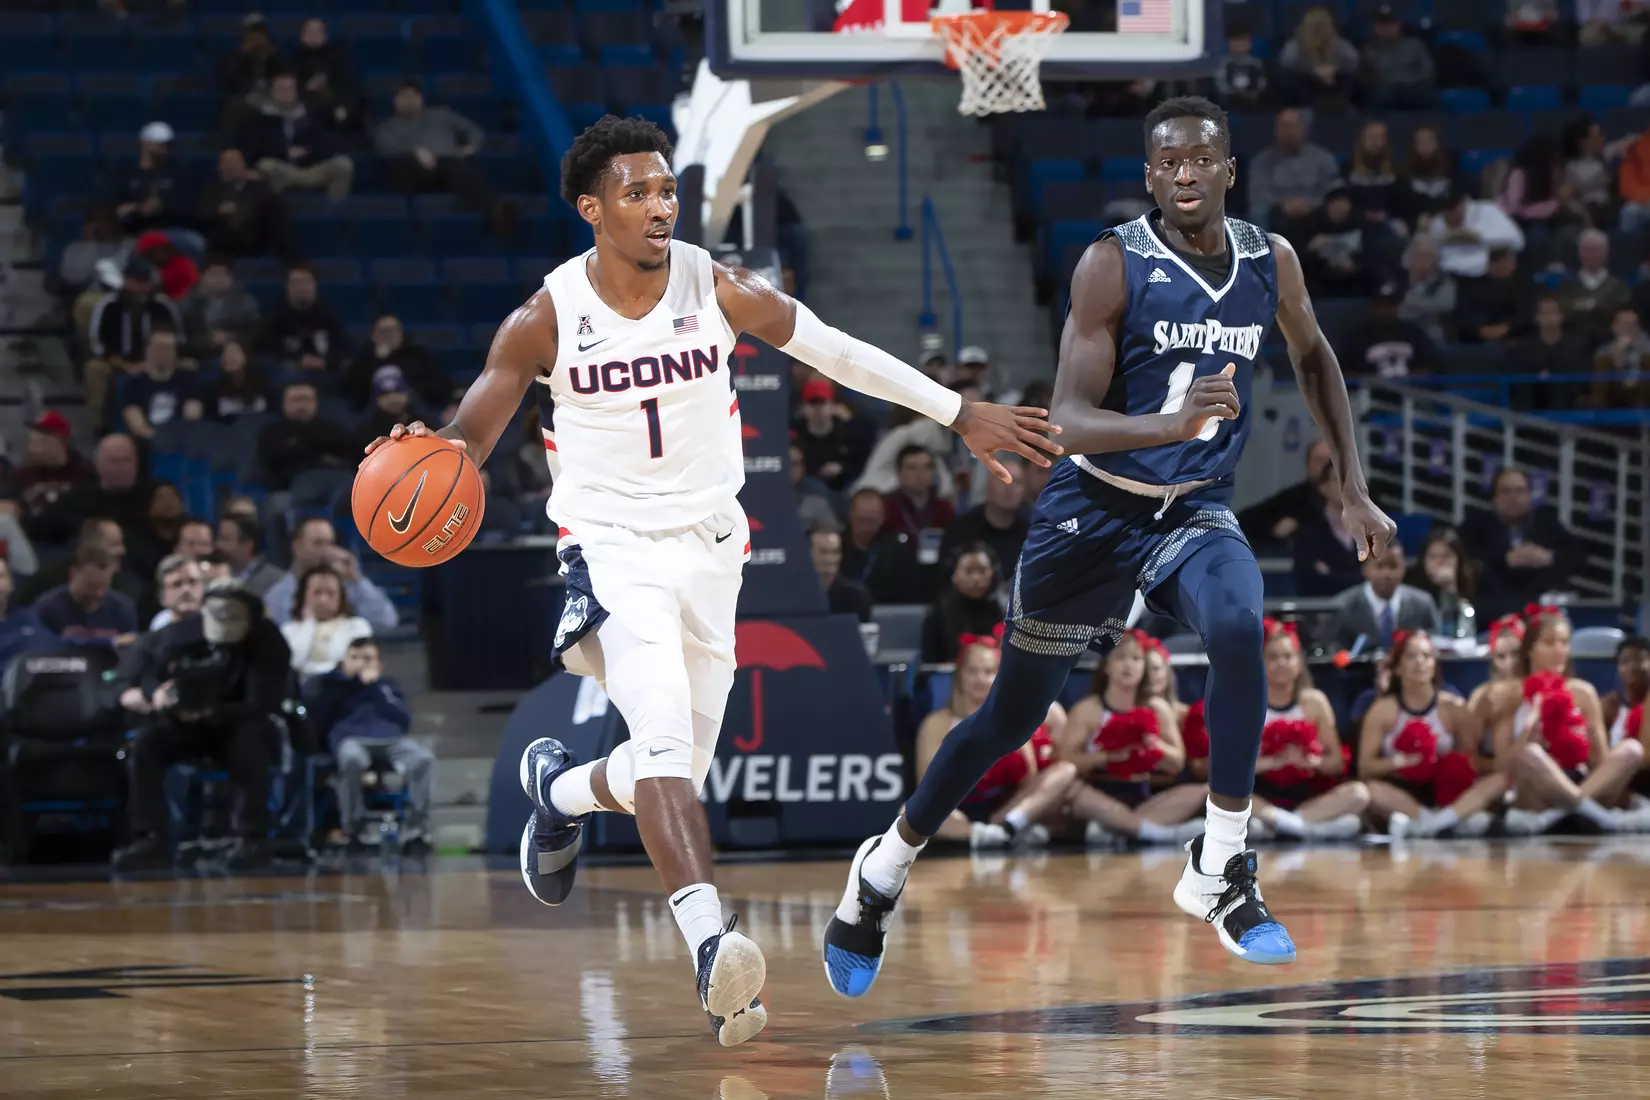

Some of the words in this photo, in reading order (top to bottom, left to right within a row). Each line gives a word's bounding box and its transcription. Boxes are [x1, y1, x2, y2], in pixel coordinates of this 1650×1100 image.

[569, 344, 718, 394] UCONN
[640, 397, 664, 459] 1
[422, 501, 469, 555] ELITE
[699, 753, 904, 803] VELERS
